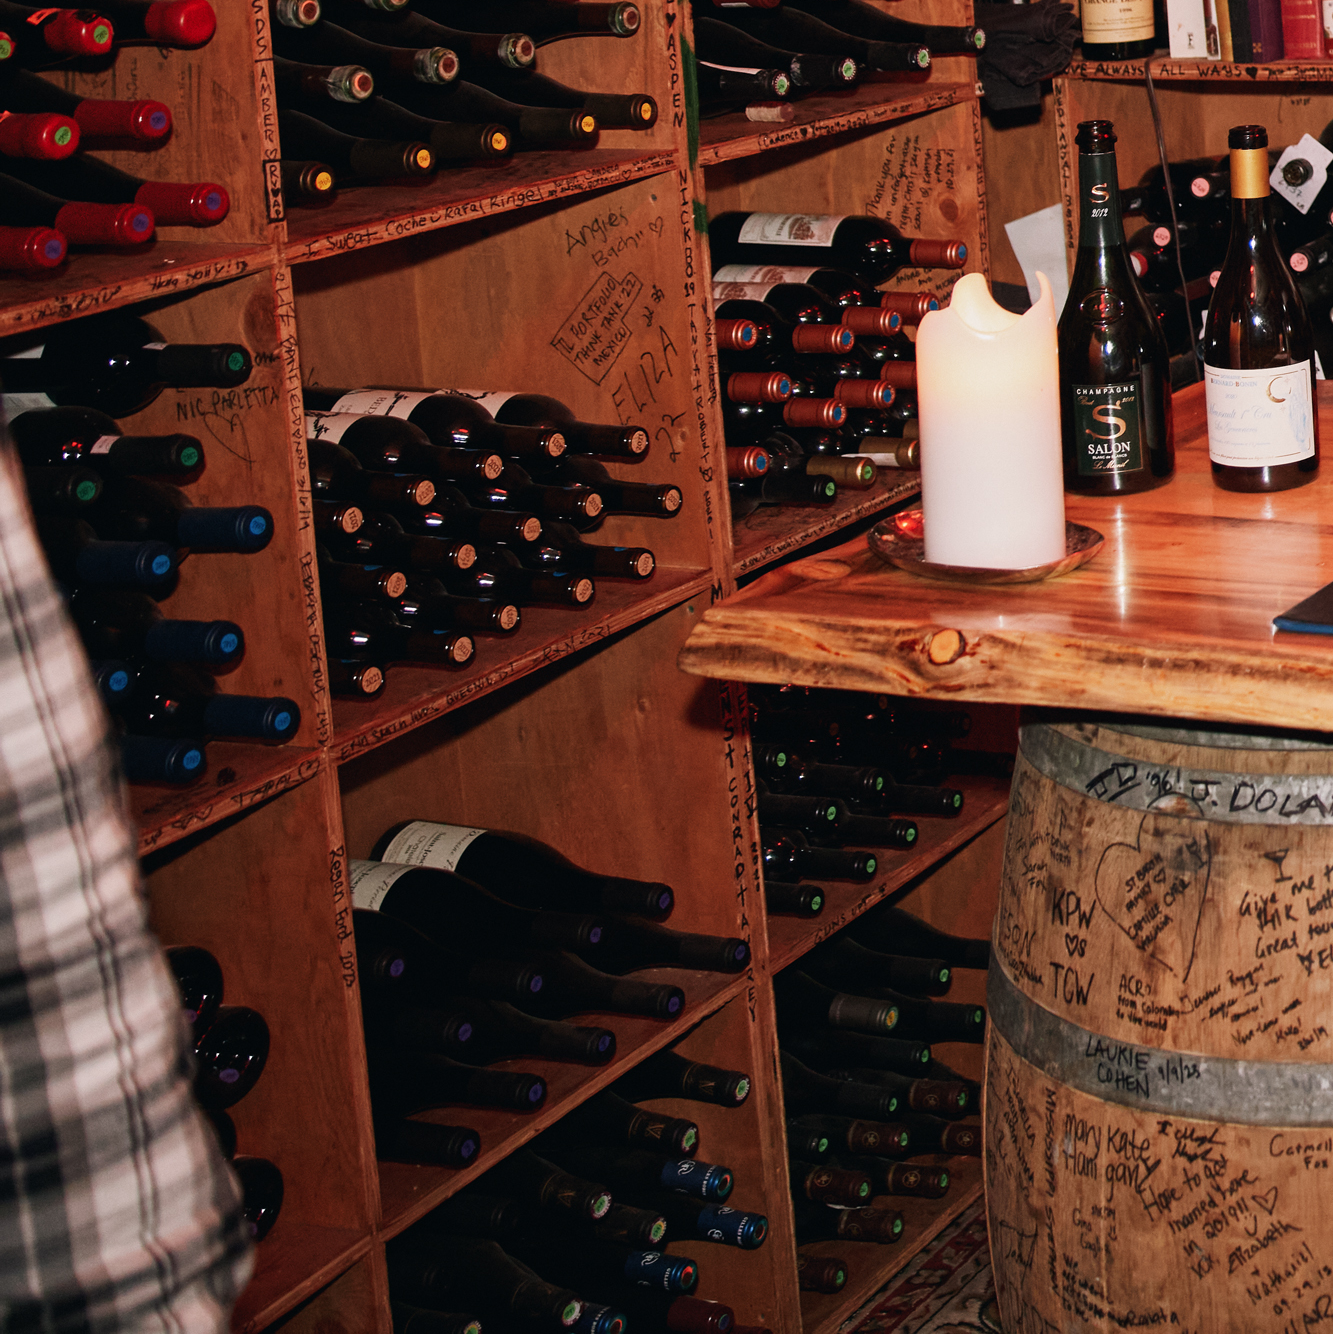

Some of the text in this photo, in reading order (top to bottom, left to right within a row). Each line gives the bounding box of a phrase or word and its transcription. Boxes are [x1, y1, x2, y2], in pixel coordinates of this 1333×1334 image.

[1076, 384, 1135, 395] CHAMPAGNE
[1087, 441, 1131, 455] SALON
[1051, 887, 1097, 931] KPW
[1049, 960, 1095, 1006] TCW
